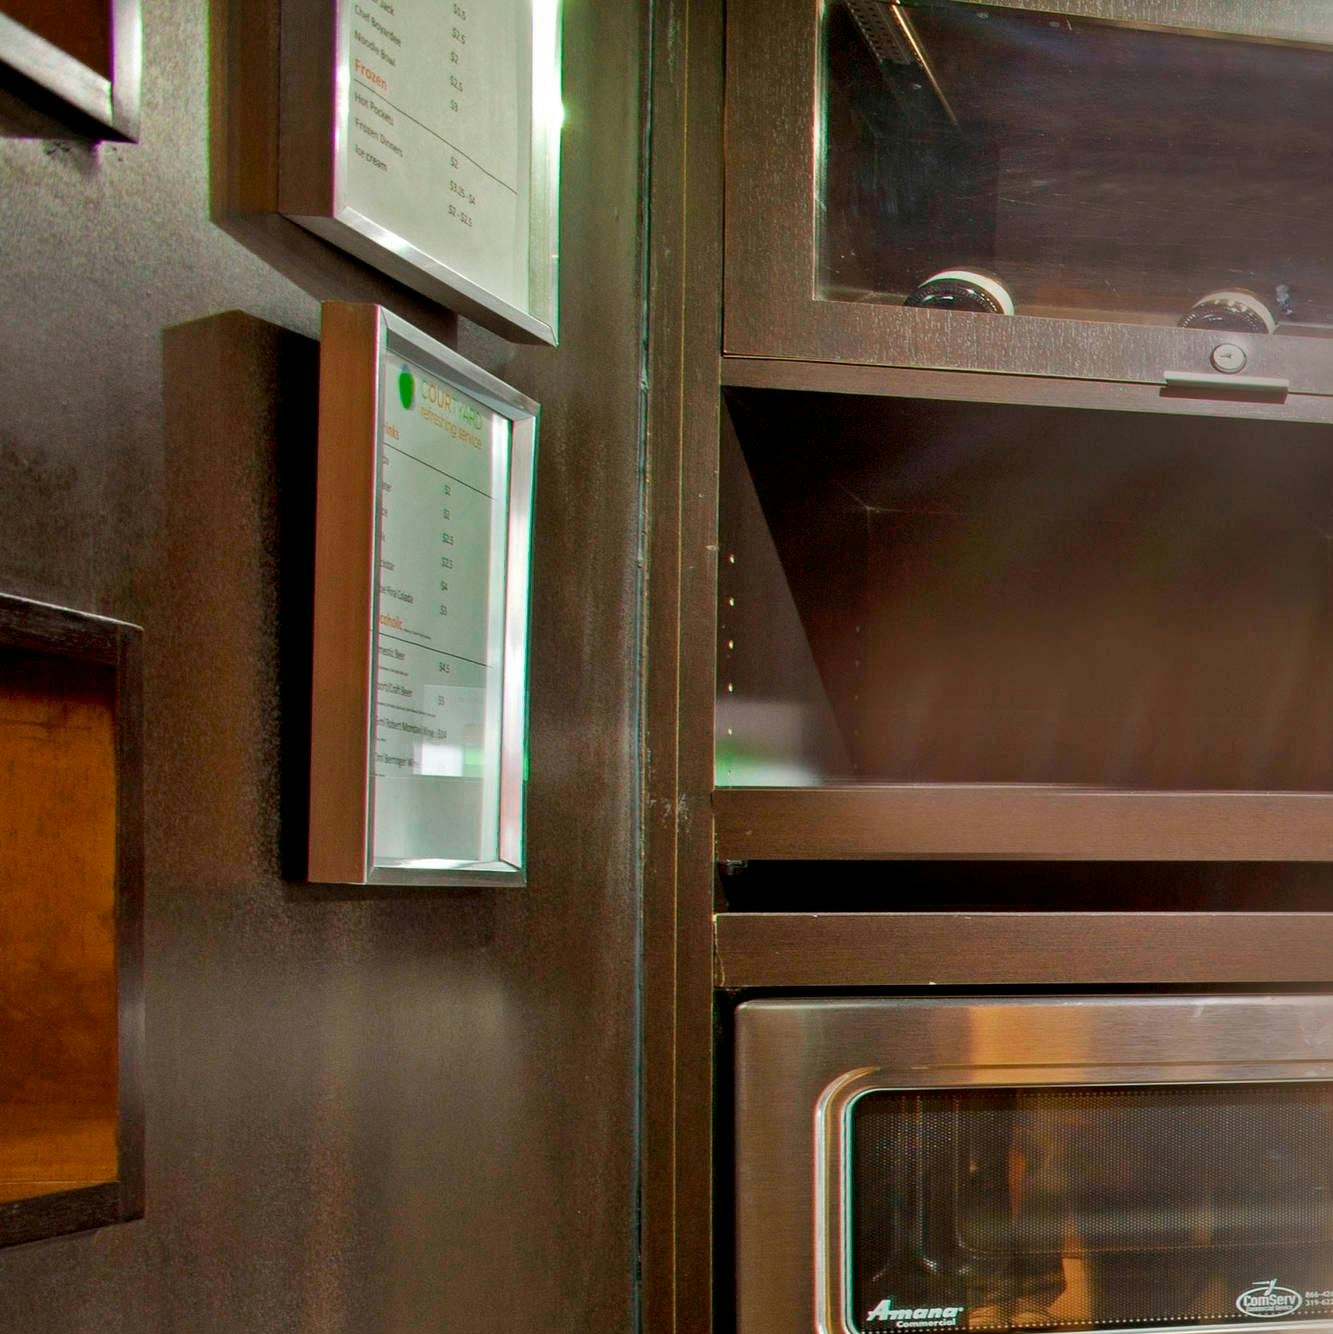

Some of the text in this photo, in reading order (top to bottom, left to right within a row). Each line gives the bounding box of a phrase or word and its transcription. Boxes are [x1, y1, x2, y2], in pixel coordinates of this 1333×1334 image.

[354, 58, 388, 91] Frozen
[1243, 1294, 1296, 1307] ComServ
[866, 1299, 959, 1321] Amana
[896, 1318, 956, 1328] Commercial
